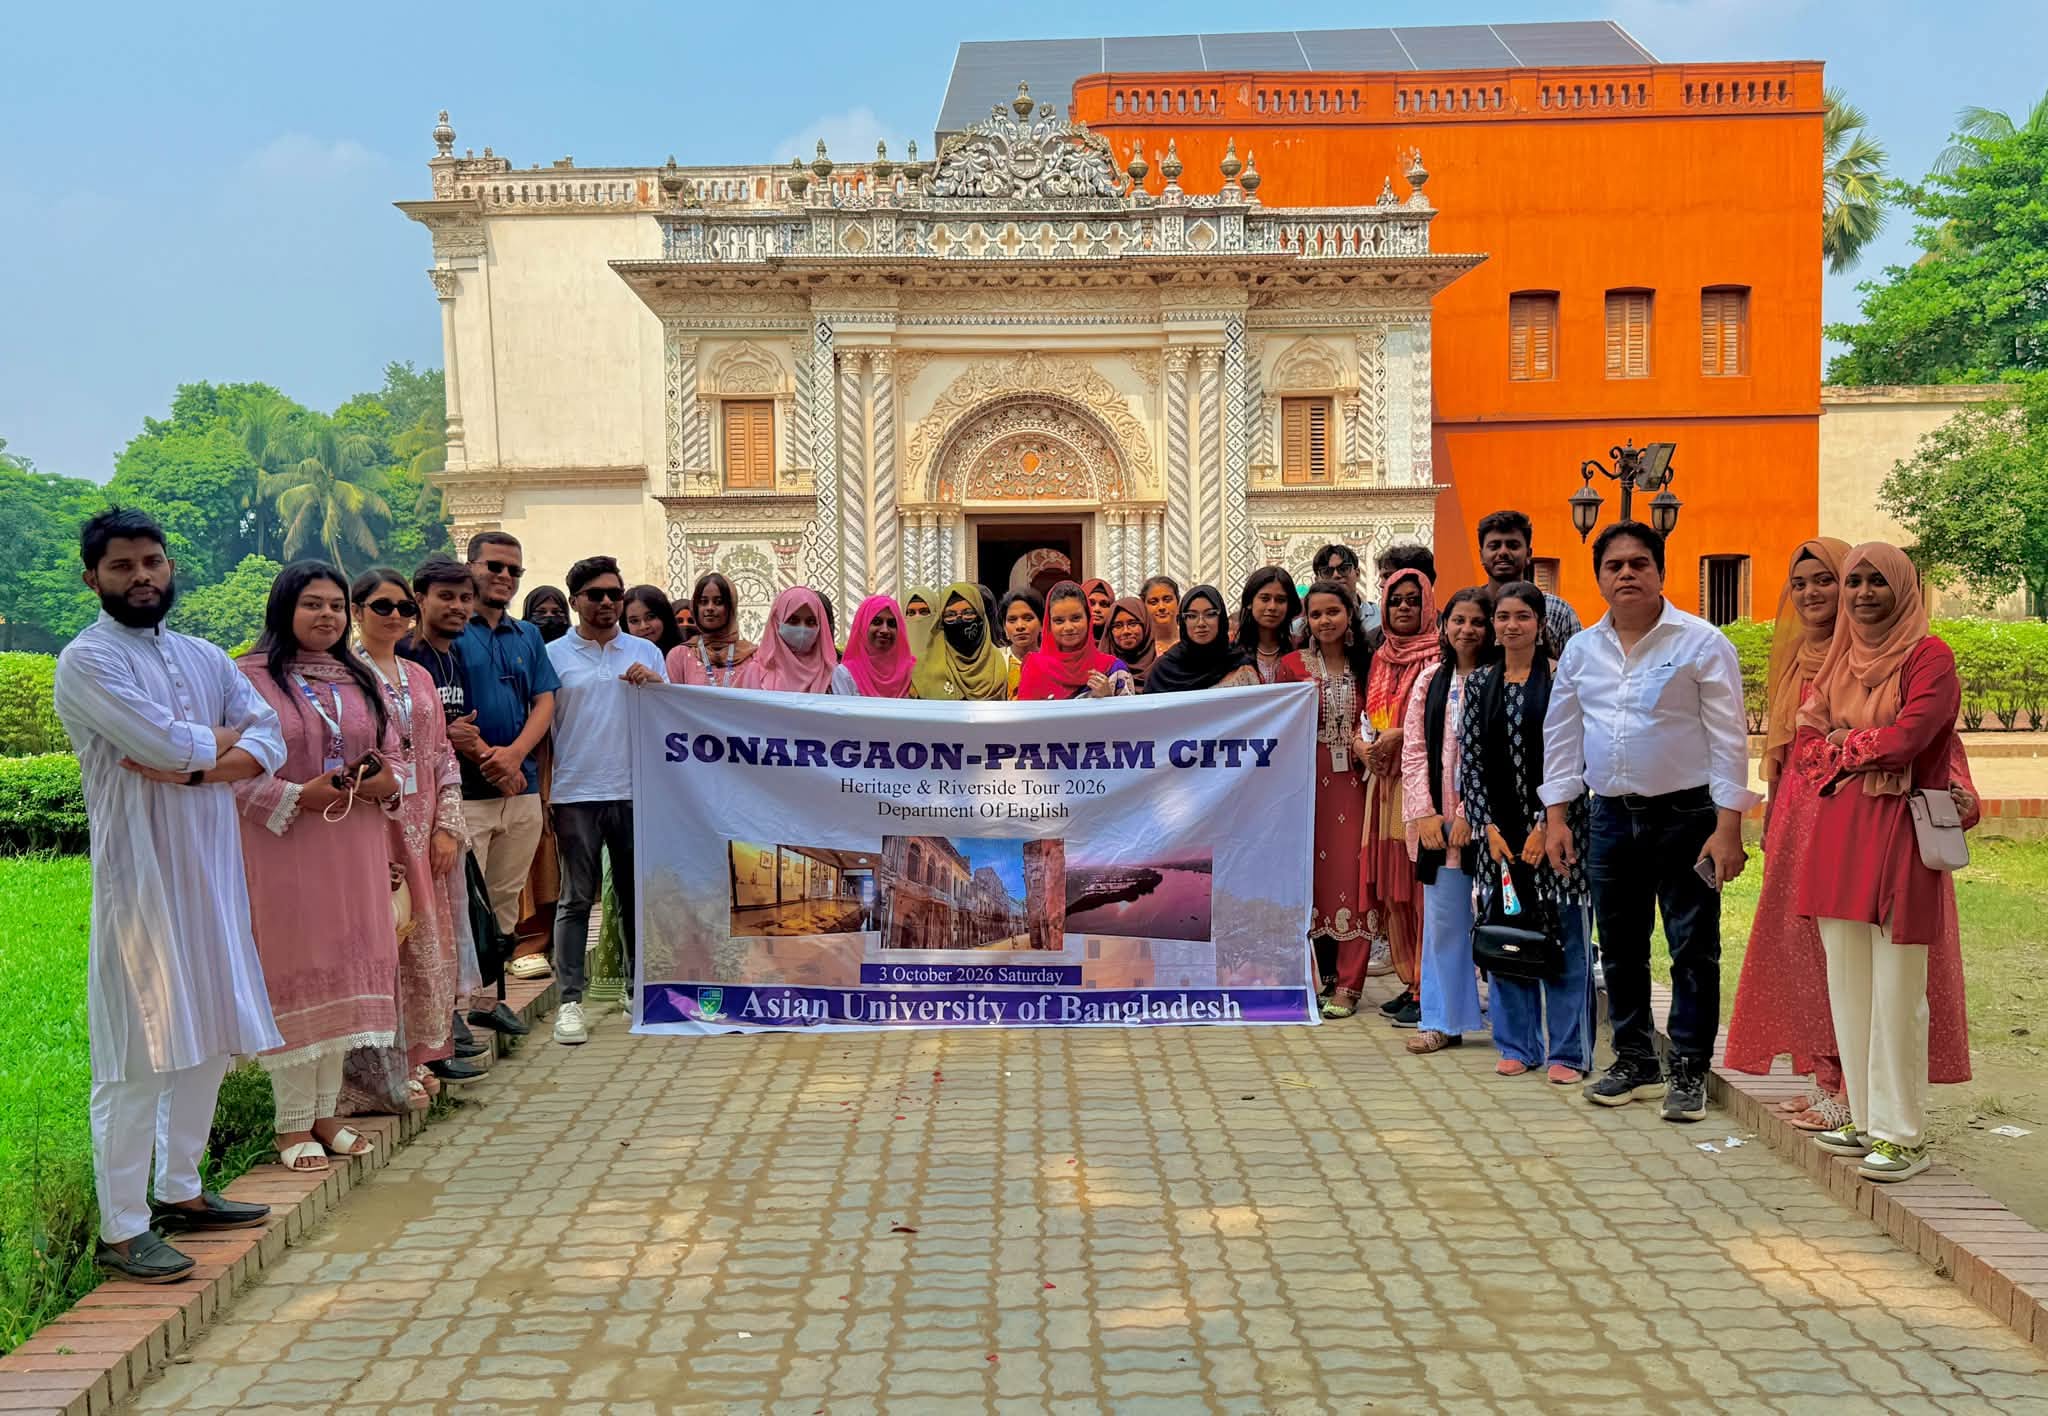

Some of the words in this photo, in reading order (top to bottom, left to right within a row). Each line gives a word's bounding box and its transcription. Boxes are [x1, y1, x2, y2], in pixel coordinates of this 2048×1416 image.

[665, 732, 1156, 770] SONARGAON-PANAM
[1169, 738, 1278, 769] CITY
[840, 778, 912, 798] Heritage
[916, 780, 931, 795] &
[938, 779, 1017, 795] Riverside
[1021, 780, 1061, 795] Tour
[1065, 780, 1107, 795] 2026
[878, 801, 974, 820] Department
[980, 802, 1004, 818] Of
[1007, 802, 1069, 821] English
[879, 967, 887, 981] 3
[892, 967, 953, 982] October
[956, 967, 994, 981] 2026
[998, 968, 1064, 985] Saturday
[739, 990, 830, 1019] Asian
[841, 992, 1009, 1025] University
[1018, 995, 1051, 1021] of
[1058, 993, 1242, 1024] Bangladesh
